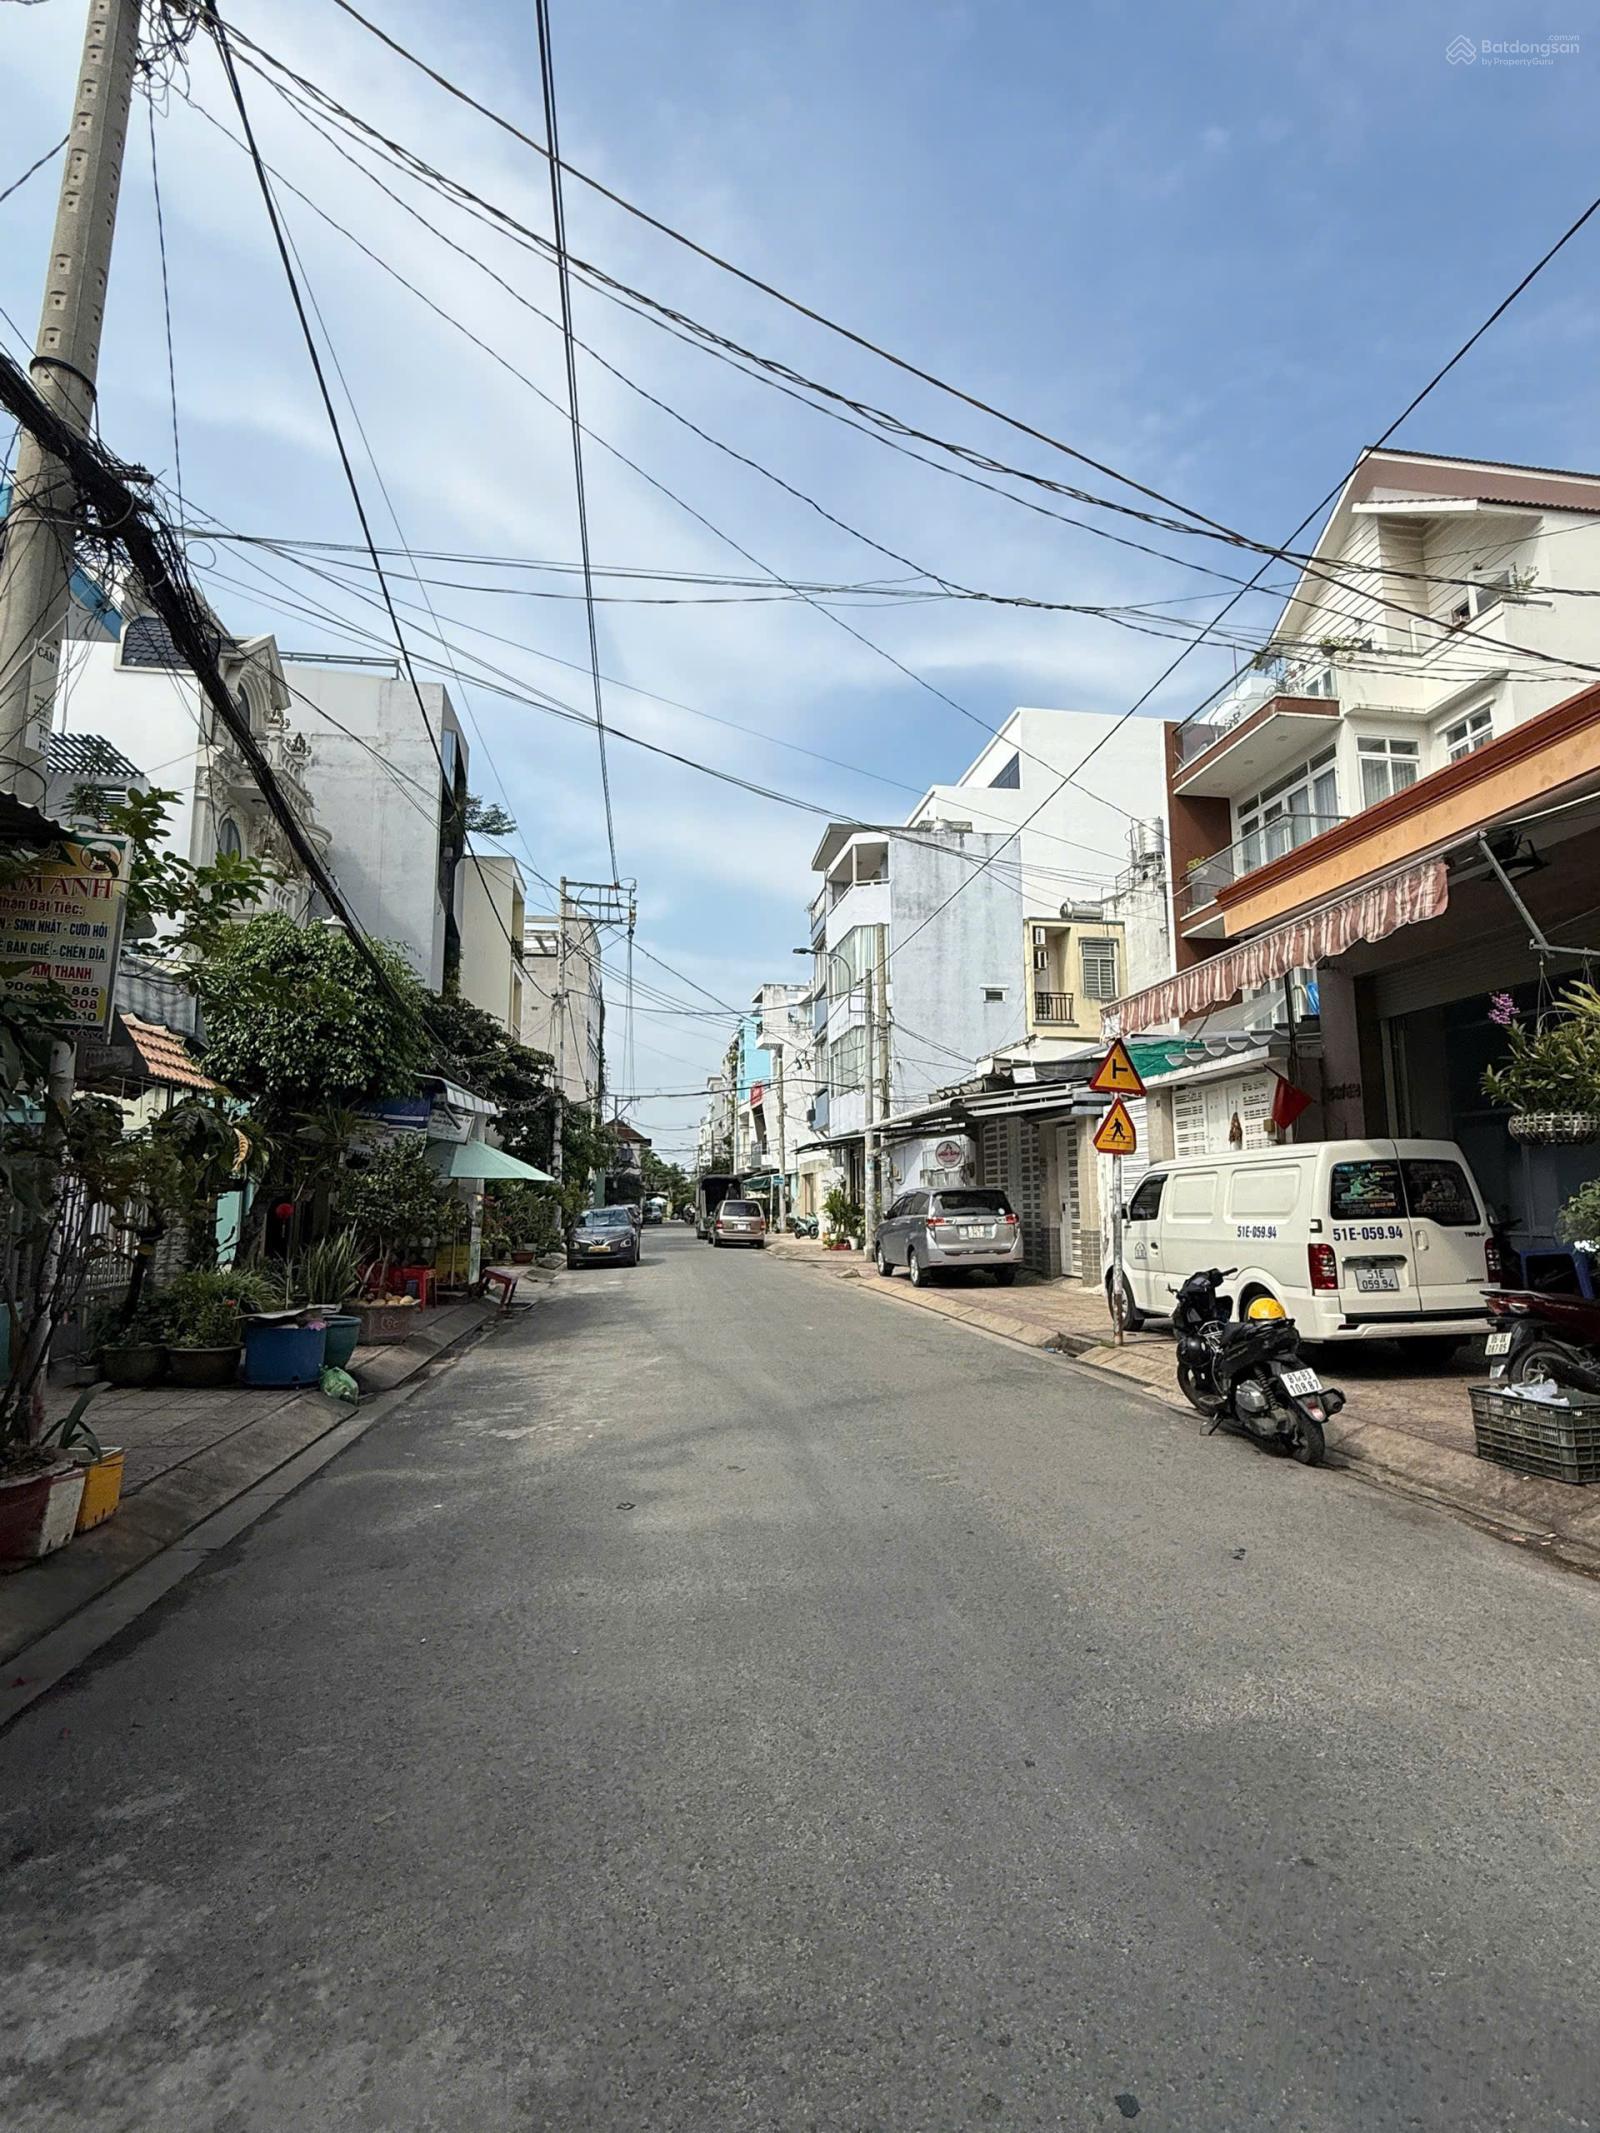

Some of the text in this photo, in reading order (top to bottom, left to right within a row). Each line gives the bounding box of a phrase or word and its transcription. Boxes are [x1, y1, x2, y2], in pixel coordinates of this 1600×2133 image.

[14, 918, 36, 931] SINH
[54, 964, 92, 980] THANH
[1237, 1225, 1277, 1239] 51E-059.94
[1332, 1225, 1404, 1242] 51E-059.94
[1367, 1269, 1386, 1280] 51E
